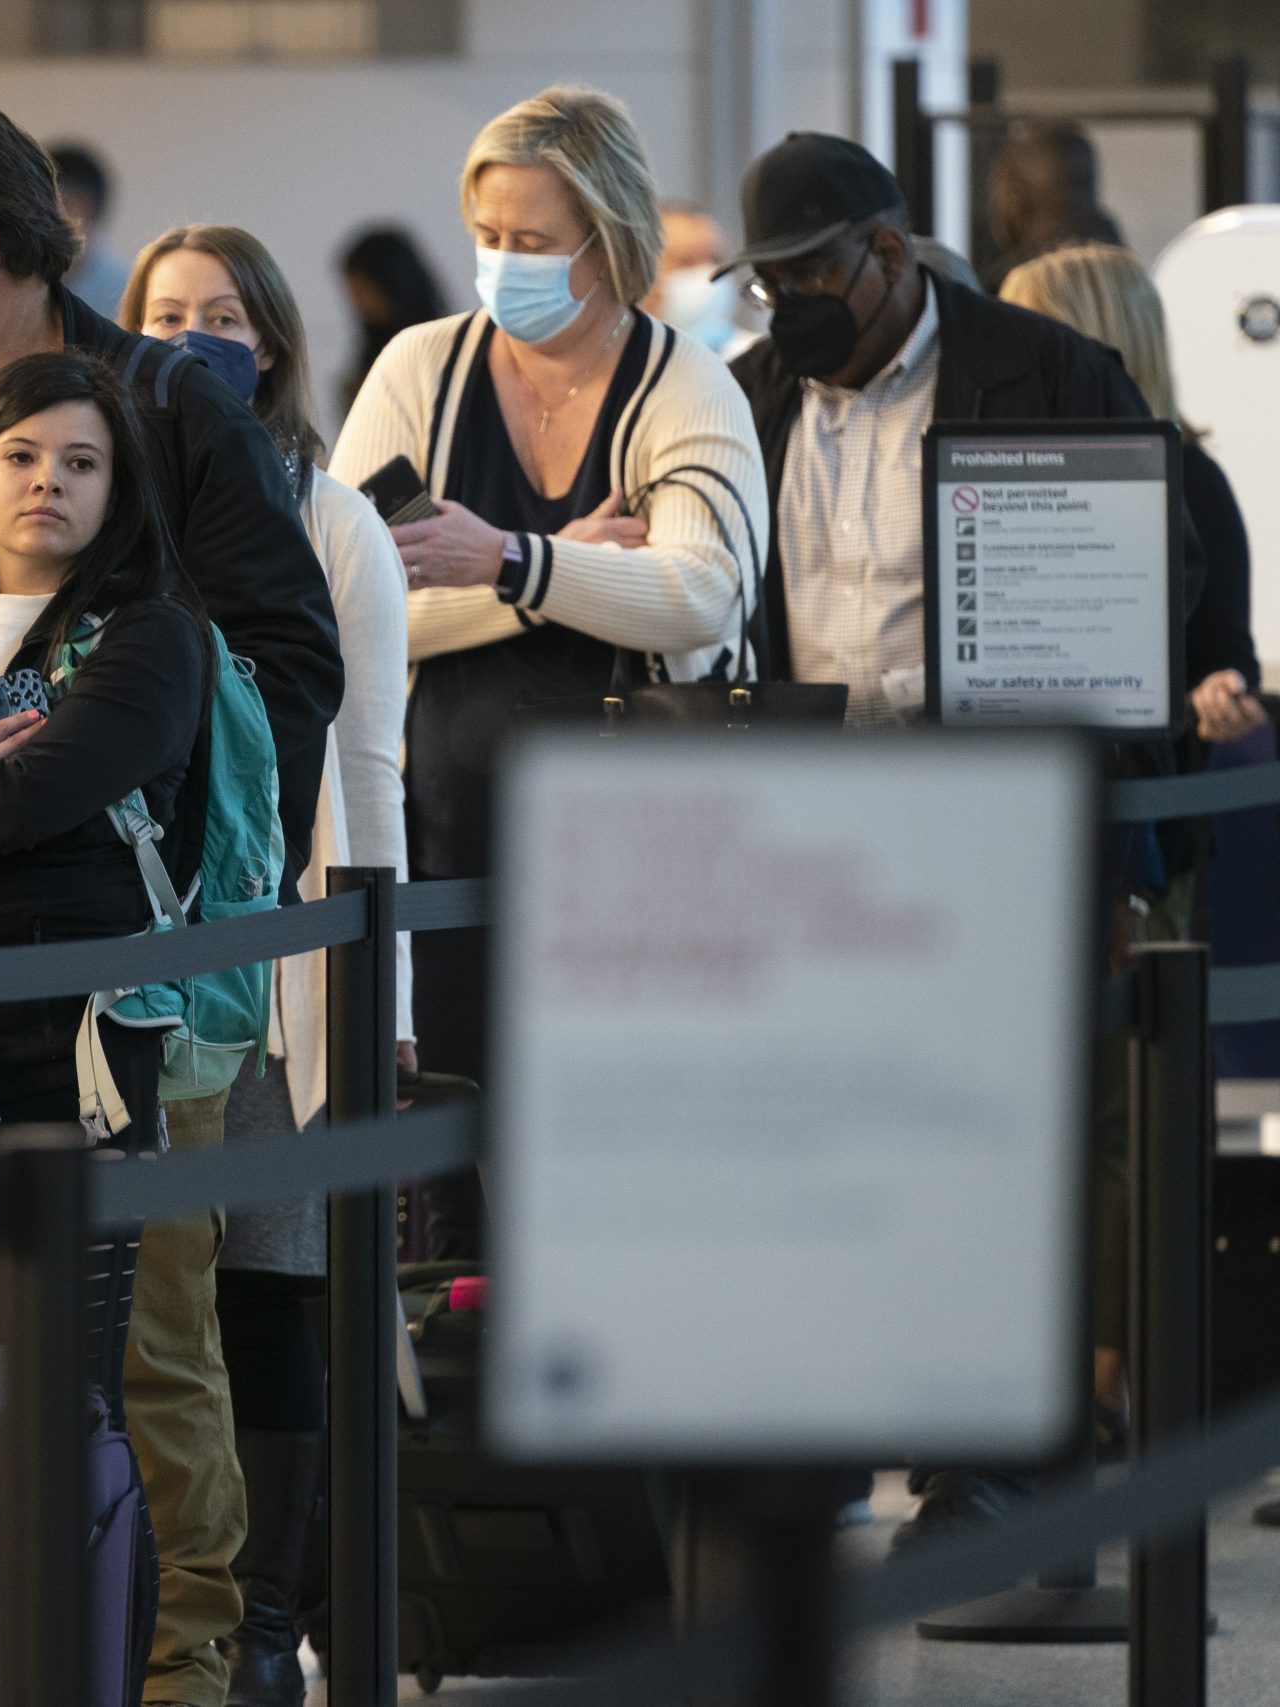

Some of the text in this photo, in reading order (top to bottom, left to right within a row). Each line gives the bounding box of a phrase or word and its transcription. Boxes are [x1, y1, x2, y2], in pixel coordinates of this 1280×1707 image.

[951, 451, 1065, 466] Prohibited Items
[982, 487, 1068, 500] Not permitted
[982, 501, 1028, 513] beyond
[1031, 500, 1053, 511] this
[967, 674, 1143, 690] Your safety is our priority
